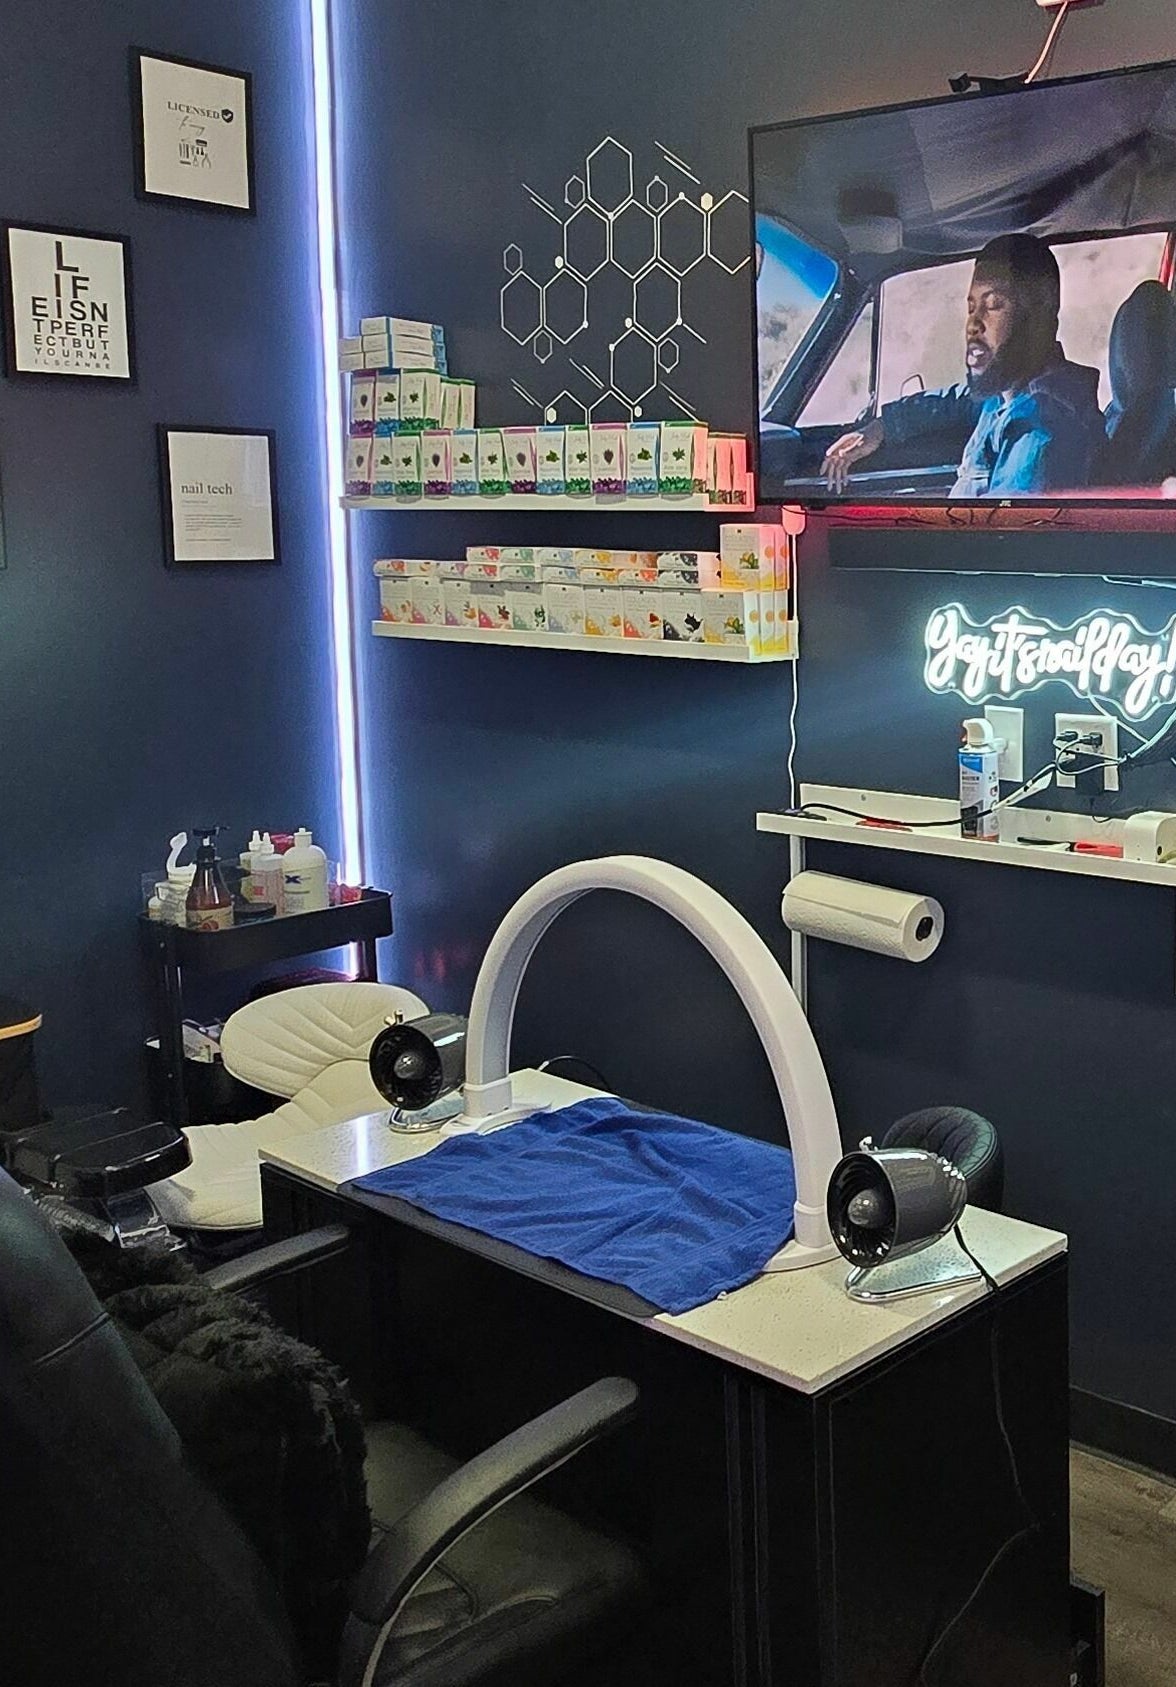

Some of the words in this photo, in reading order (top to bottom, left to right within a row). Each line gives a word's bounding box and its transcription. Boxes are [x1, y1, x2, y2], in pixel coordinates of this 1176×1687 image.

[168, 101, 220, 120] LICENSED
[55, 241, 79, 272] L
[31, 296, 108, 322] EISN
[32, 318, 108, 338] TPERF
[34, 335, 109, 350] ECTBUT
[181, 483, 203, 494] nail
[207, 483, 233, 495] tech
